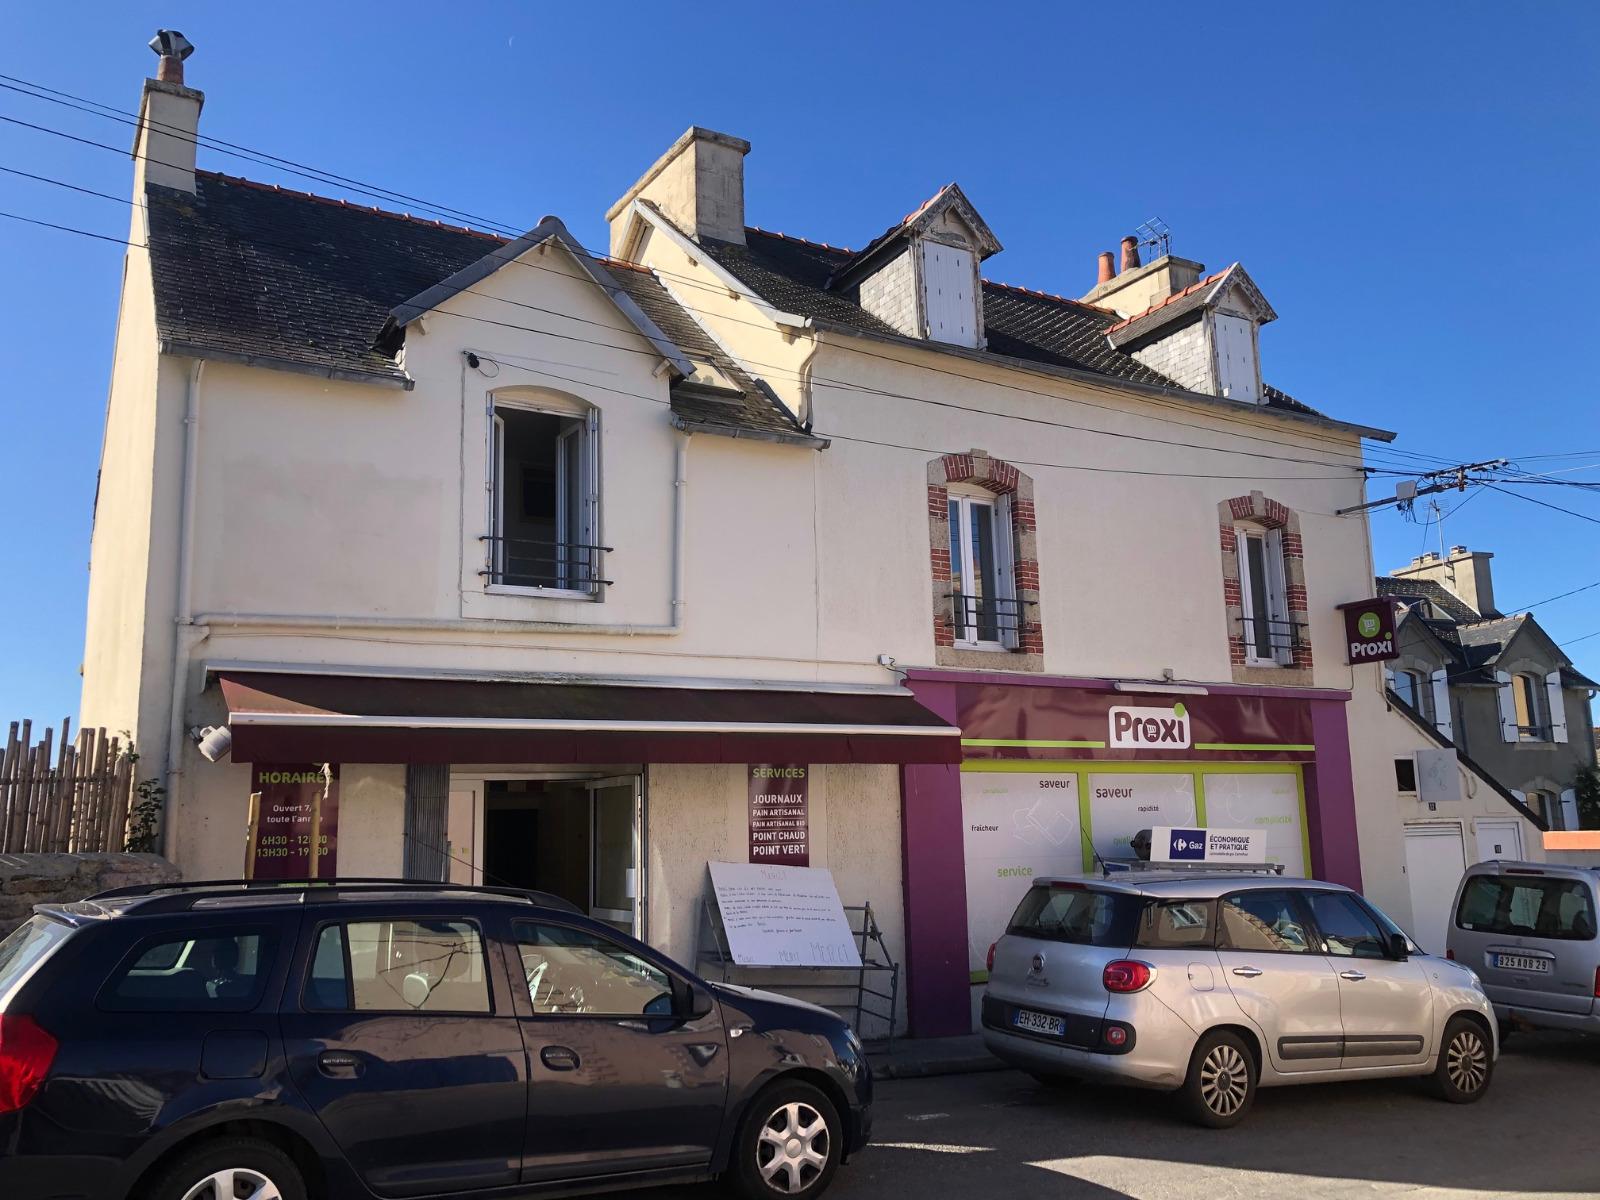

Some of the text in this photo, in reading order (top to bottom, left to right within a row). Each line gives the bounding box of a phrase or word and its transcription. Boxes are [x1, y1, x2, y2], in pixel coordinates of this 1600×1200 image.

[1351, 632, 1393, 658] Proxi
[1114, 703, 1186, 743] Proxi
[752, 768, 805, 779] SERVICES
[1039, 780, 1070, 789] saveur
[1095, 788, 1133, 798] saveur
[753, 794, 803, 804] JOURNAUX
[752, 808, 805, 817] PAIN ARTISANAL
[752, 820, 766, 828] PAIN
[261, 835, 287, 846] 6H30
[753, 831, 806, 841] POINT CHAUD
[1209, 834, 1250, 844] ÉCONOMIQUE
[753, 844, 806, 856] POINT VERT
[1188, 841, 1203, 850] Gaz
[1210, 843, 1249, 852] ET PRATIQUE
[256, 847, 288, 857] 13H30
[997, 866, 1033, 877] service
[1500, 957, 1515, 966] 925
[1535, 960, 1547, 970] 29
